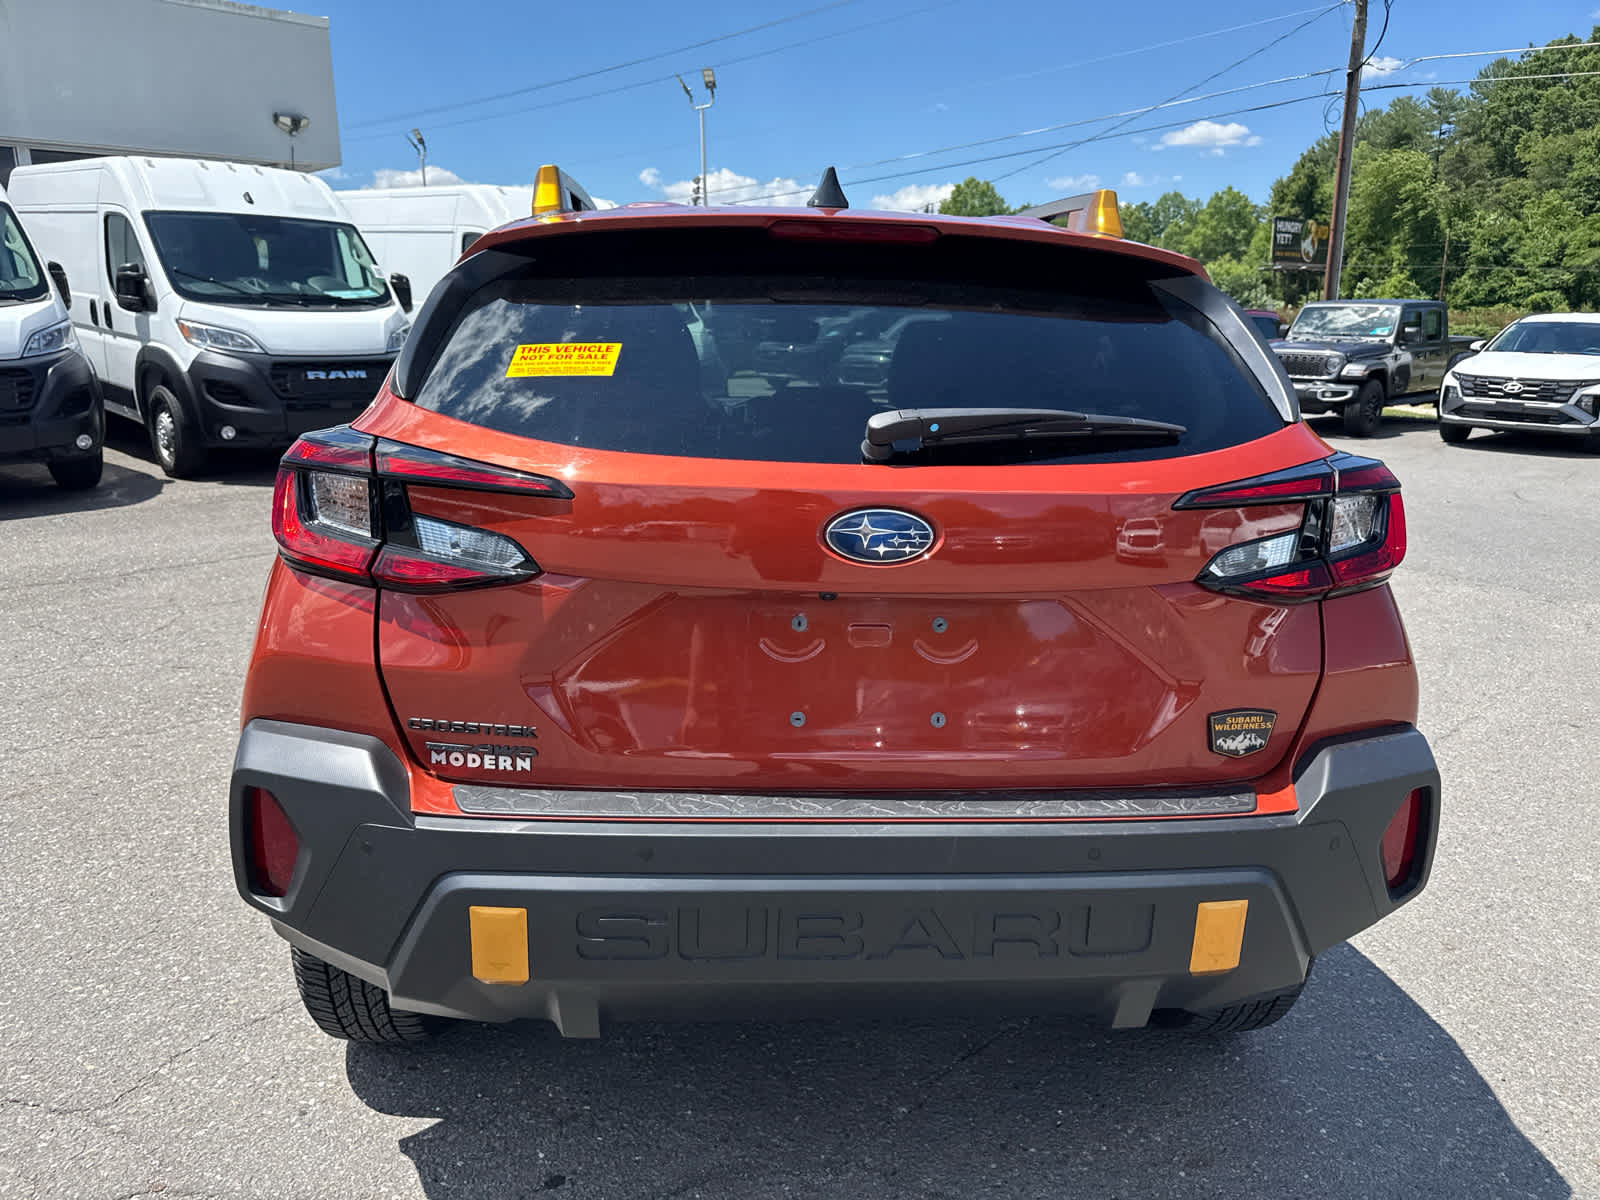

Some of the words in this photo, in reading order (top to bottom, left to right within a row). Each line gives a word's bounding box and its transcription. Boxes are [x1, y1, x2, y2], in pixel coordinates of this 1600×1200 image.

[1276, 220, 1302, 233] HUNGRY
[1276, 232, 1293, 245] YET?
[520, 346, 551, 354] THIS
[555, 345, 615, 353] VEHICLE
[306, 370, 367, 379] RAM
[1214, 721, 1272, 731] WILDERNESS
[1225, 715, 1264, 724] SUBARU
[407, 717, 538, 738] CROSSTREK
[430, 750, 531, 772] MODERN
[575, 902, 1156, 961] SUBARU
